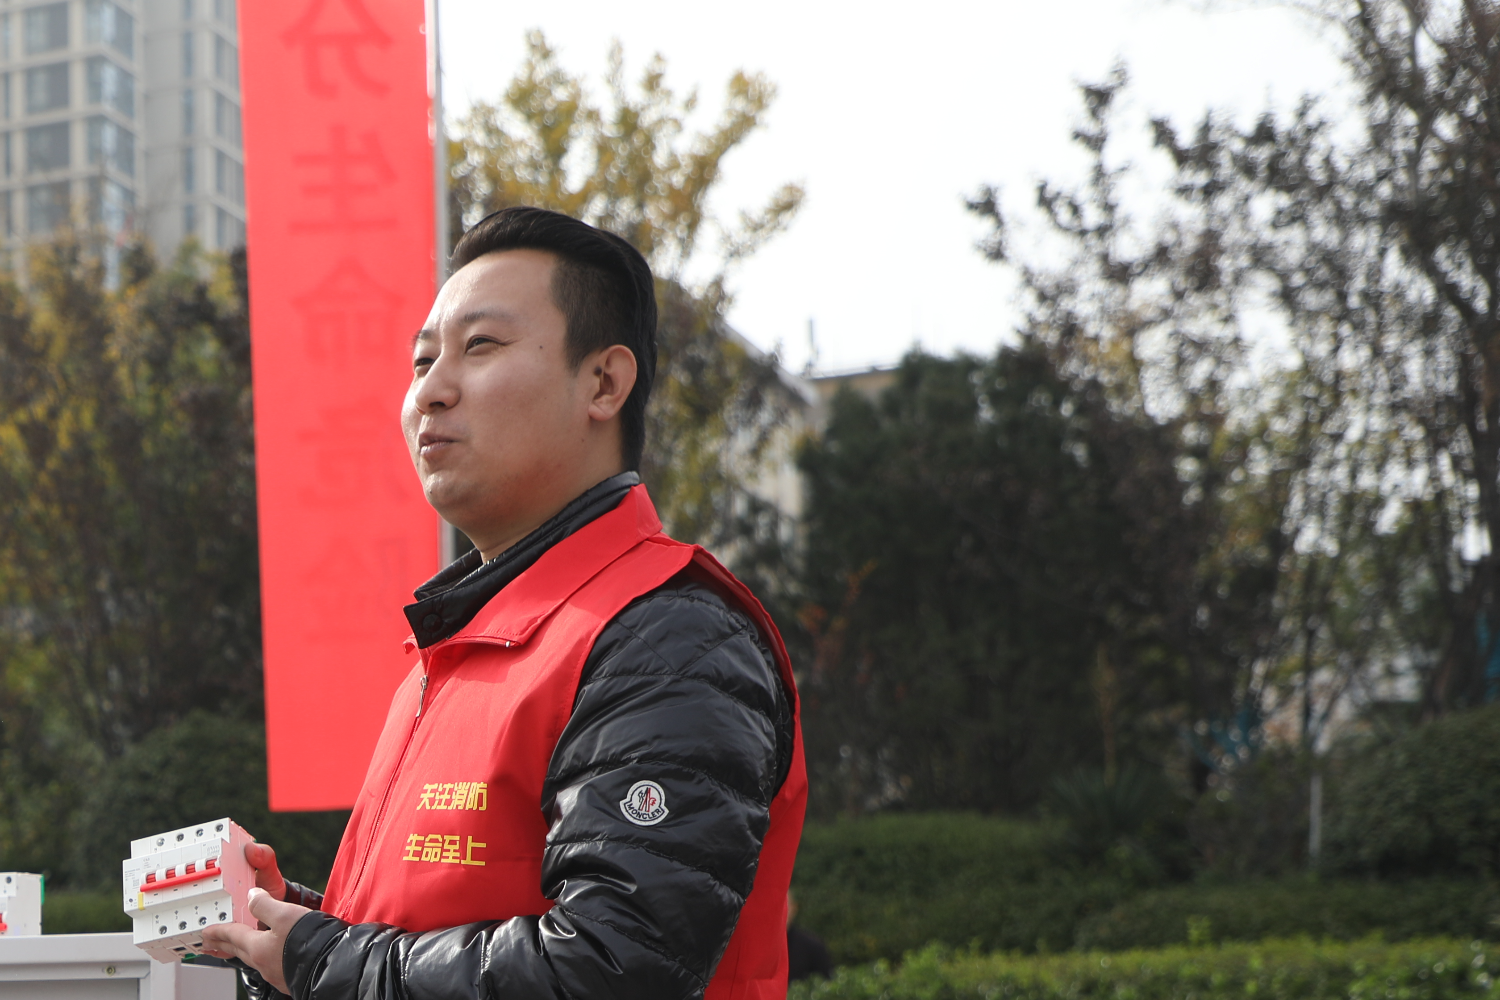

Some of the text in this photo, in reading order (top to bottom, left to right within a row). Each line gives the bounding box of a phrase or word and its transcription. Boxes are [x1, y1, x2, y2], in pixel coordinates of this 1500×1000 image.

[415, 781, 488, 811] 关注消防
[627, 802, 662, 820] MONCLER
[402, 833, 487, 867] 生命至上
